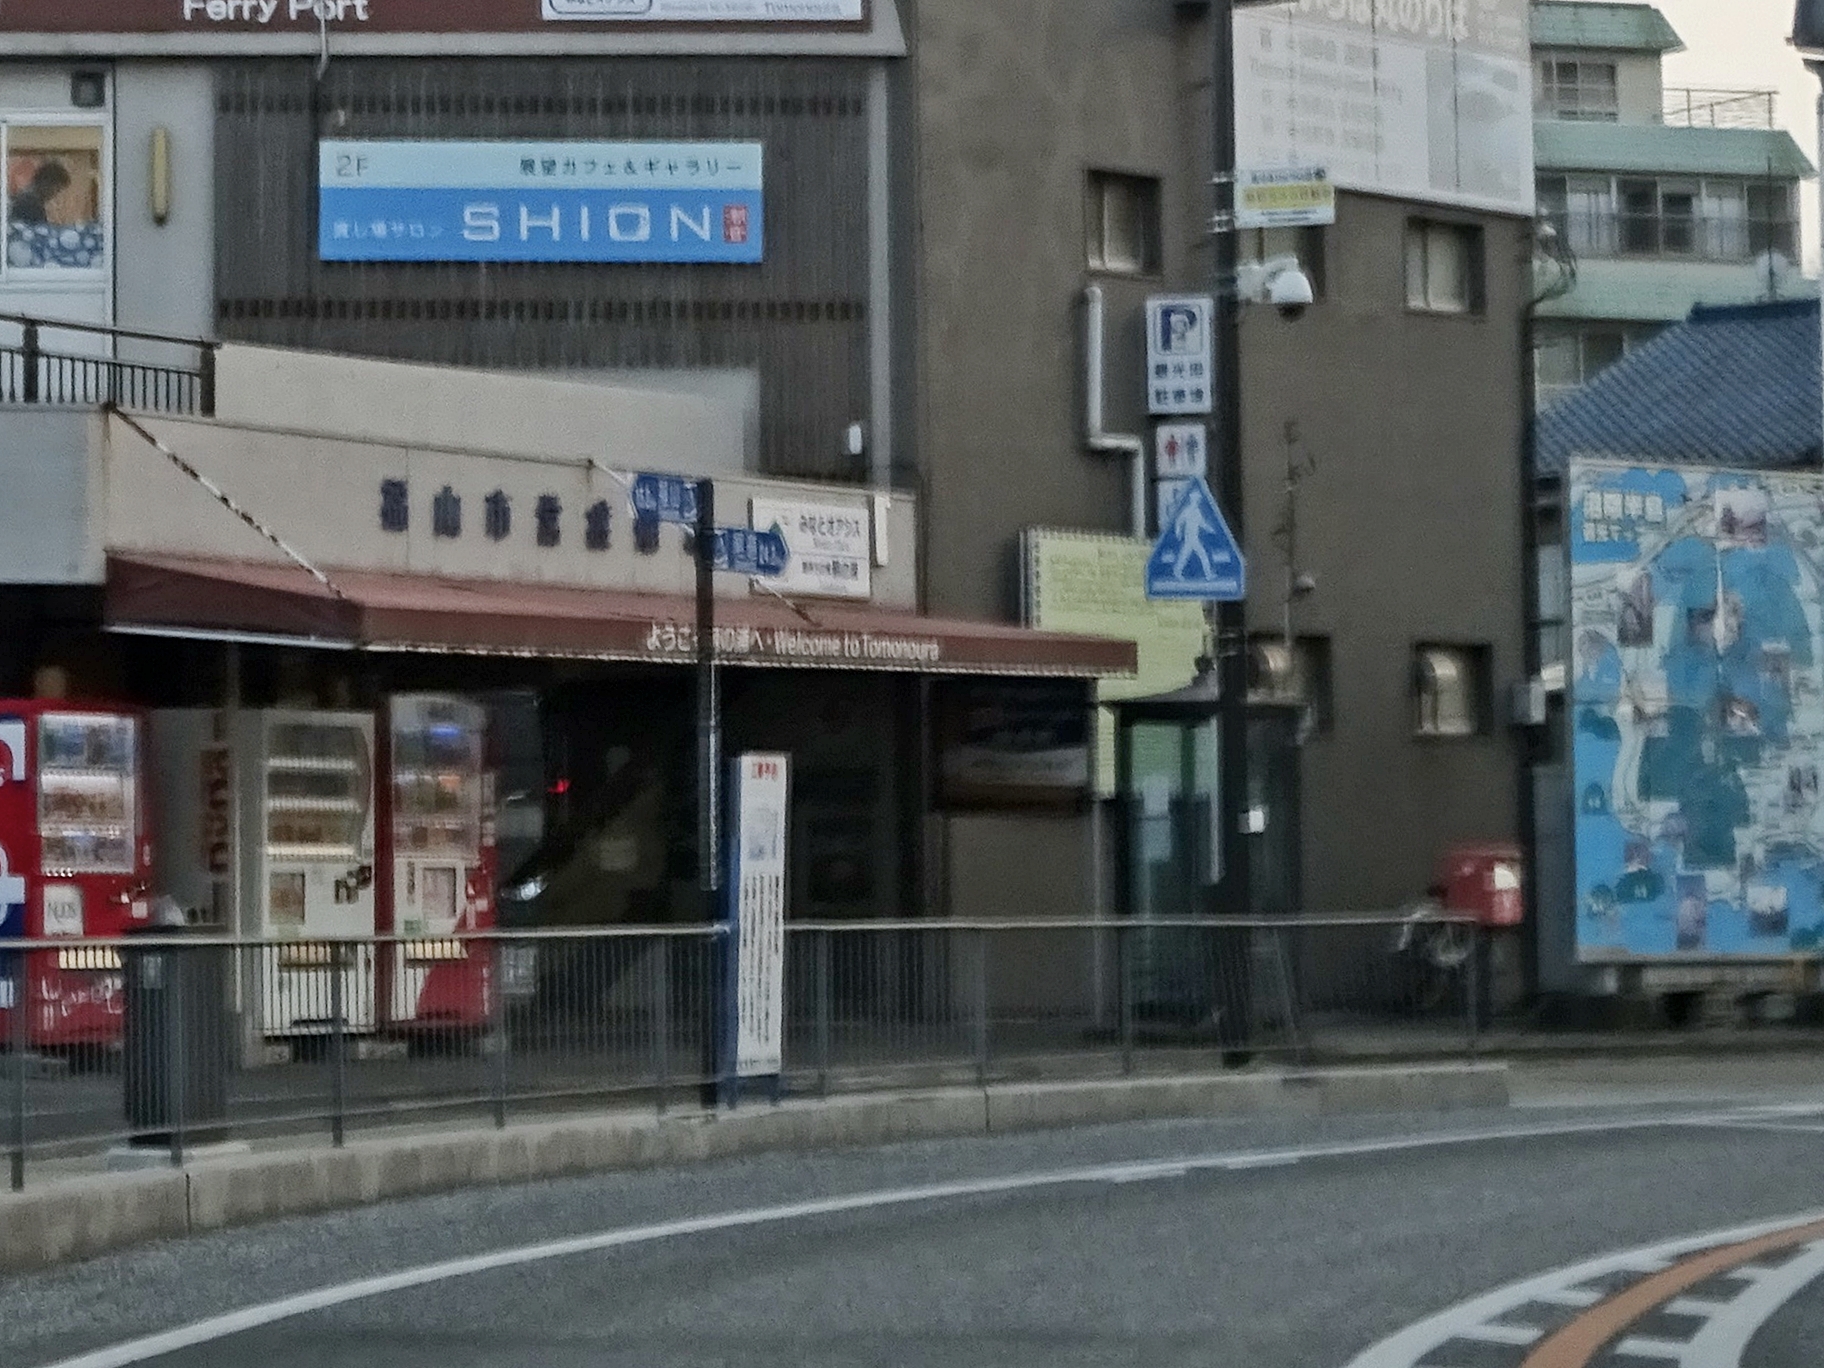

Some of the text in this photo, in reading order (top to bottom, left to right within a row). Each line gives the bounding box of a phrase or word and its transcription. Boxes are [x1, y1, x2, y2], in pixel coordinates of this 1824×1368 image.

[335, 155, 369, 178] 2F
[462, 203, 711, 242] SHION
[775, 630, 842, 657] Welcome
[844, 634, 860, 658] to
